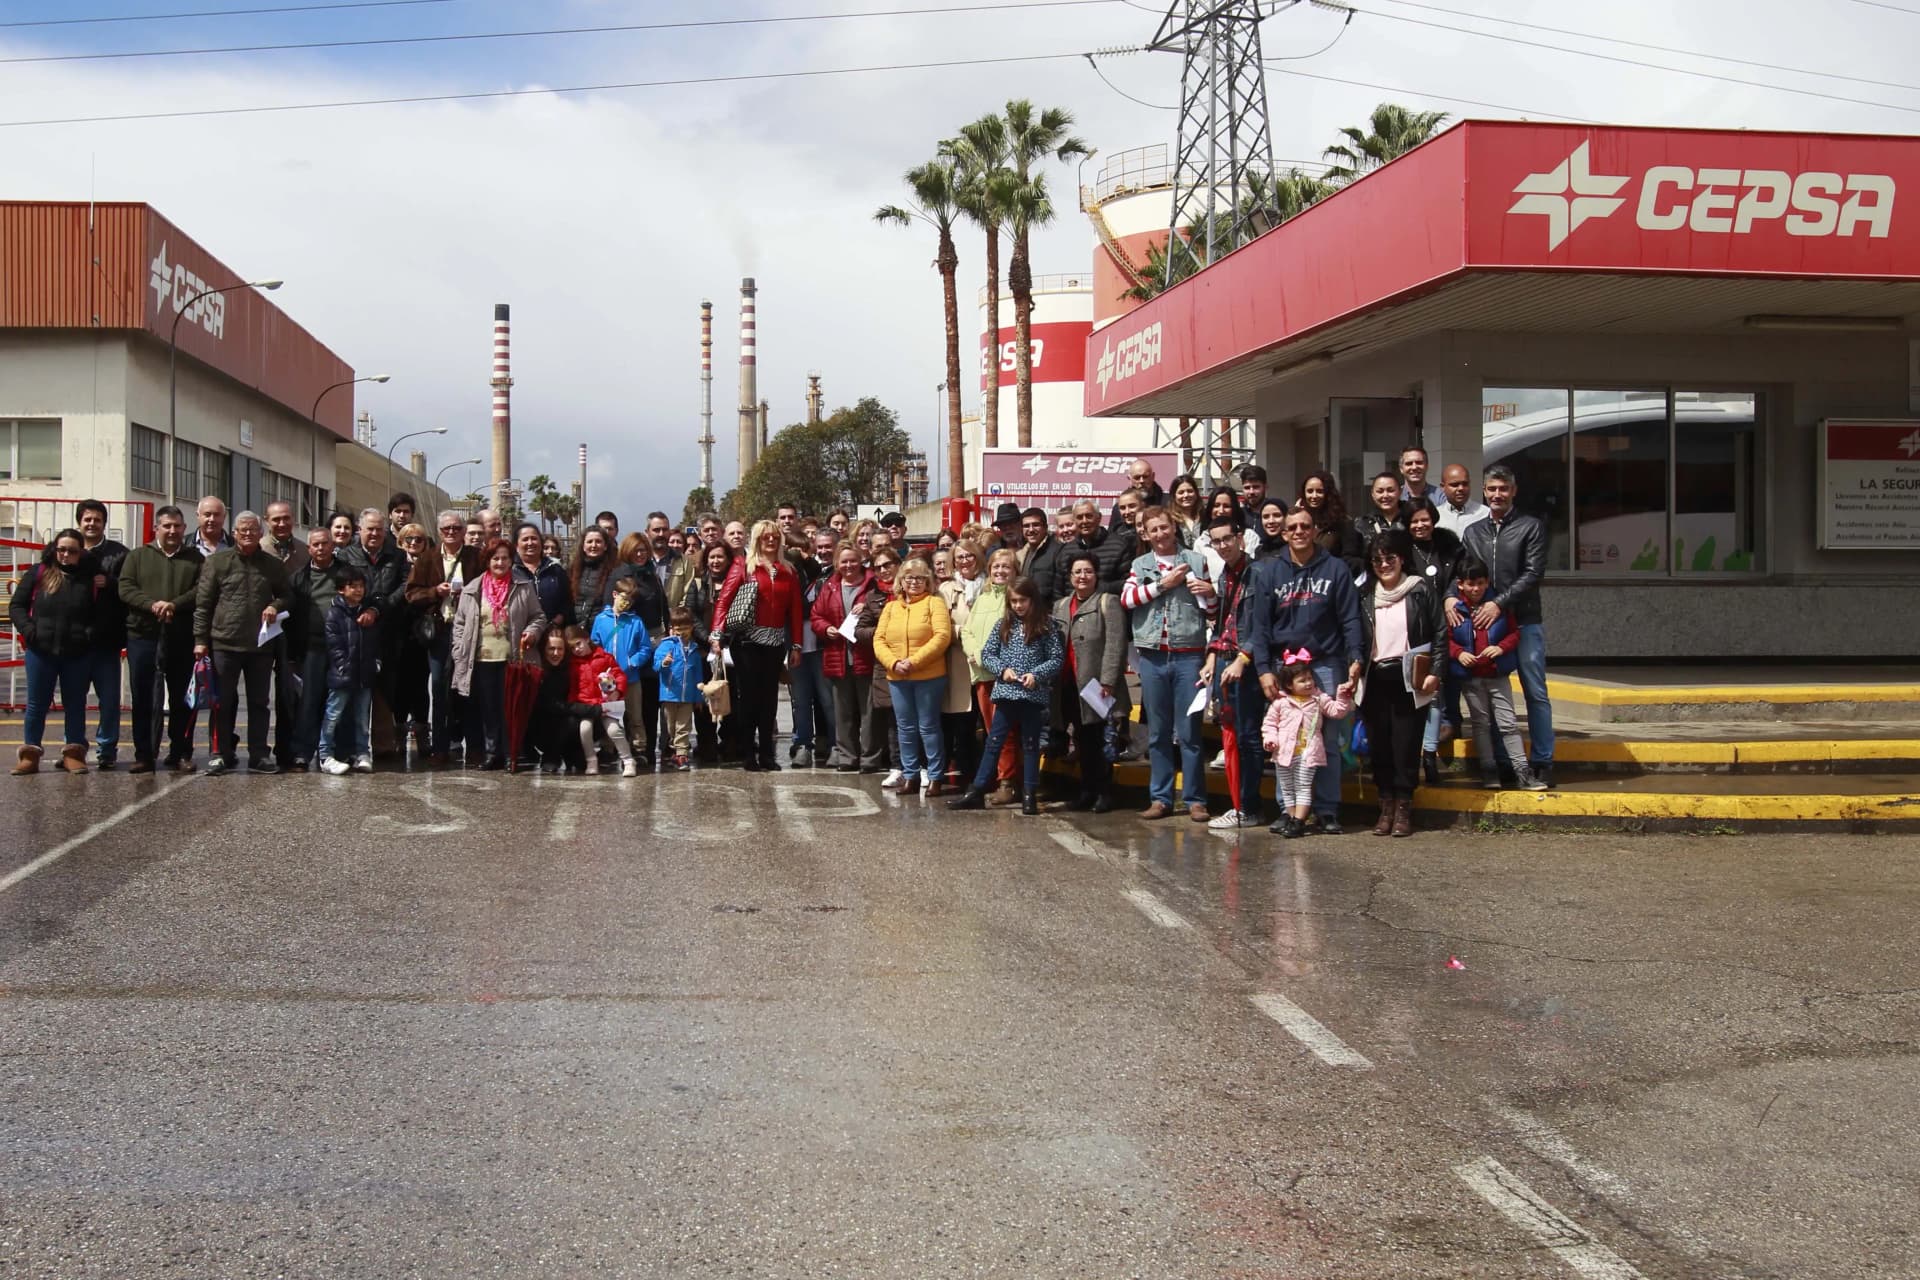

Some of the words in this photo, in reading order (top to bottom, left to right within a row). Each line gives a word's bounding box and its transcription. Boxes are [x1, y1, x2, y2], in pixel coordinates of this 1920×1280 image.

[1636, 165, 1896, 238] CEPSA
[172, 263, 225, 340] CEPSA
[1116, 321, 1162, 381] CEPSA
[1860, 479, 1877, 489] LA
[360, 775, 882, 842] STOP
